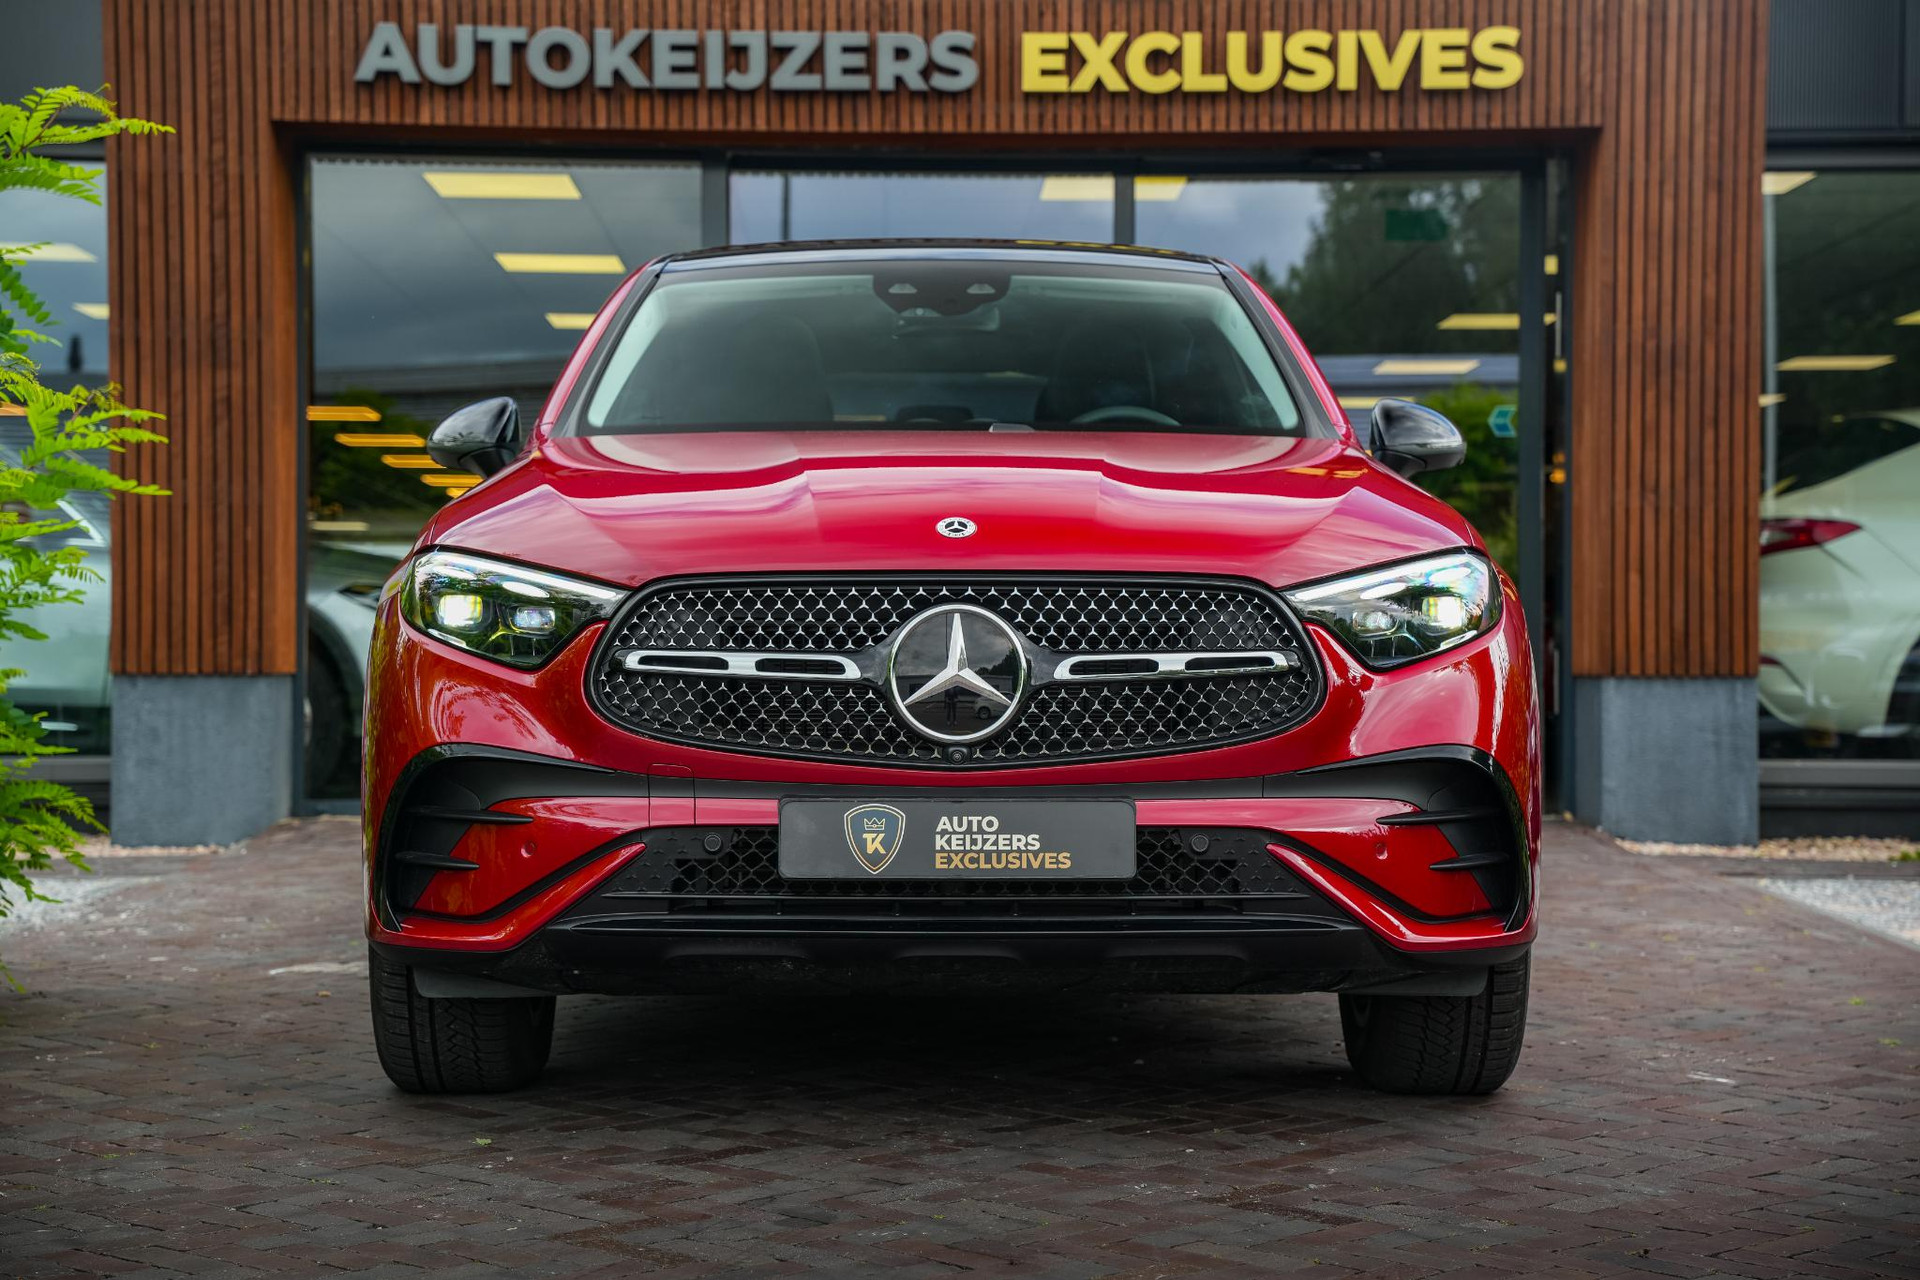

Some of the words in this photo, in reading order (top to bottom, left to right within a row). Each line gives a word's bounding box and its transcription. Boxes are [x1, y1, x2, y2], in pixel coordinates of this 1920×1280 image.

[354, 21, 980, 92] AUTOKEIJZERS
[1021, 26, 1525, 94] EXCLUSIVES
[935, 815, 999, 832] AUTO
[935, 834, 1041, 851] KEIJZERS
[935, 852, 1072, 869] EXCLUSIVES
